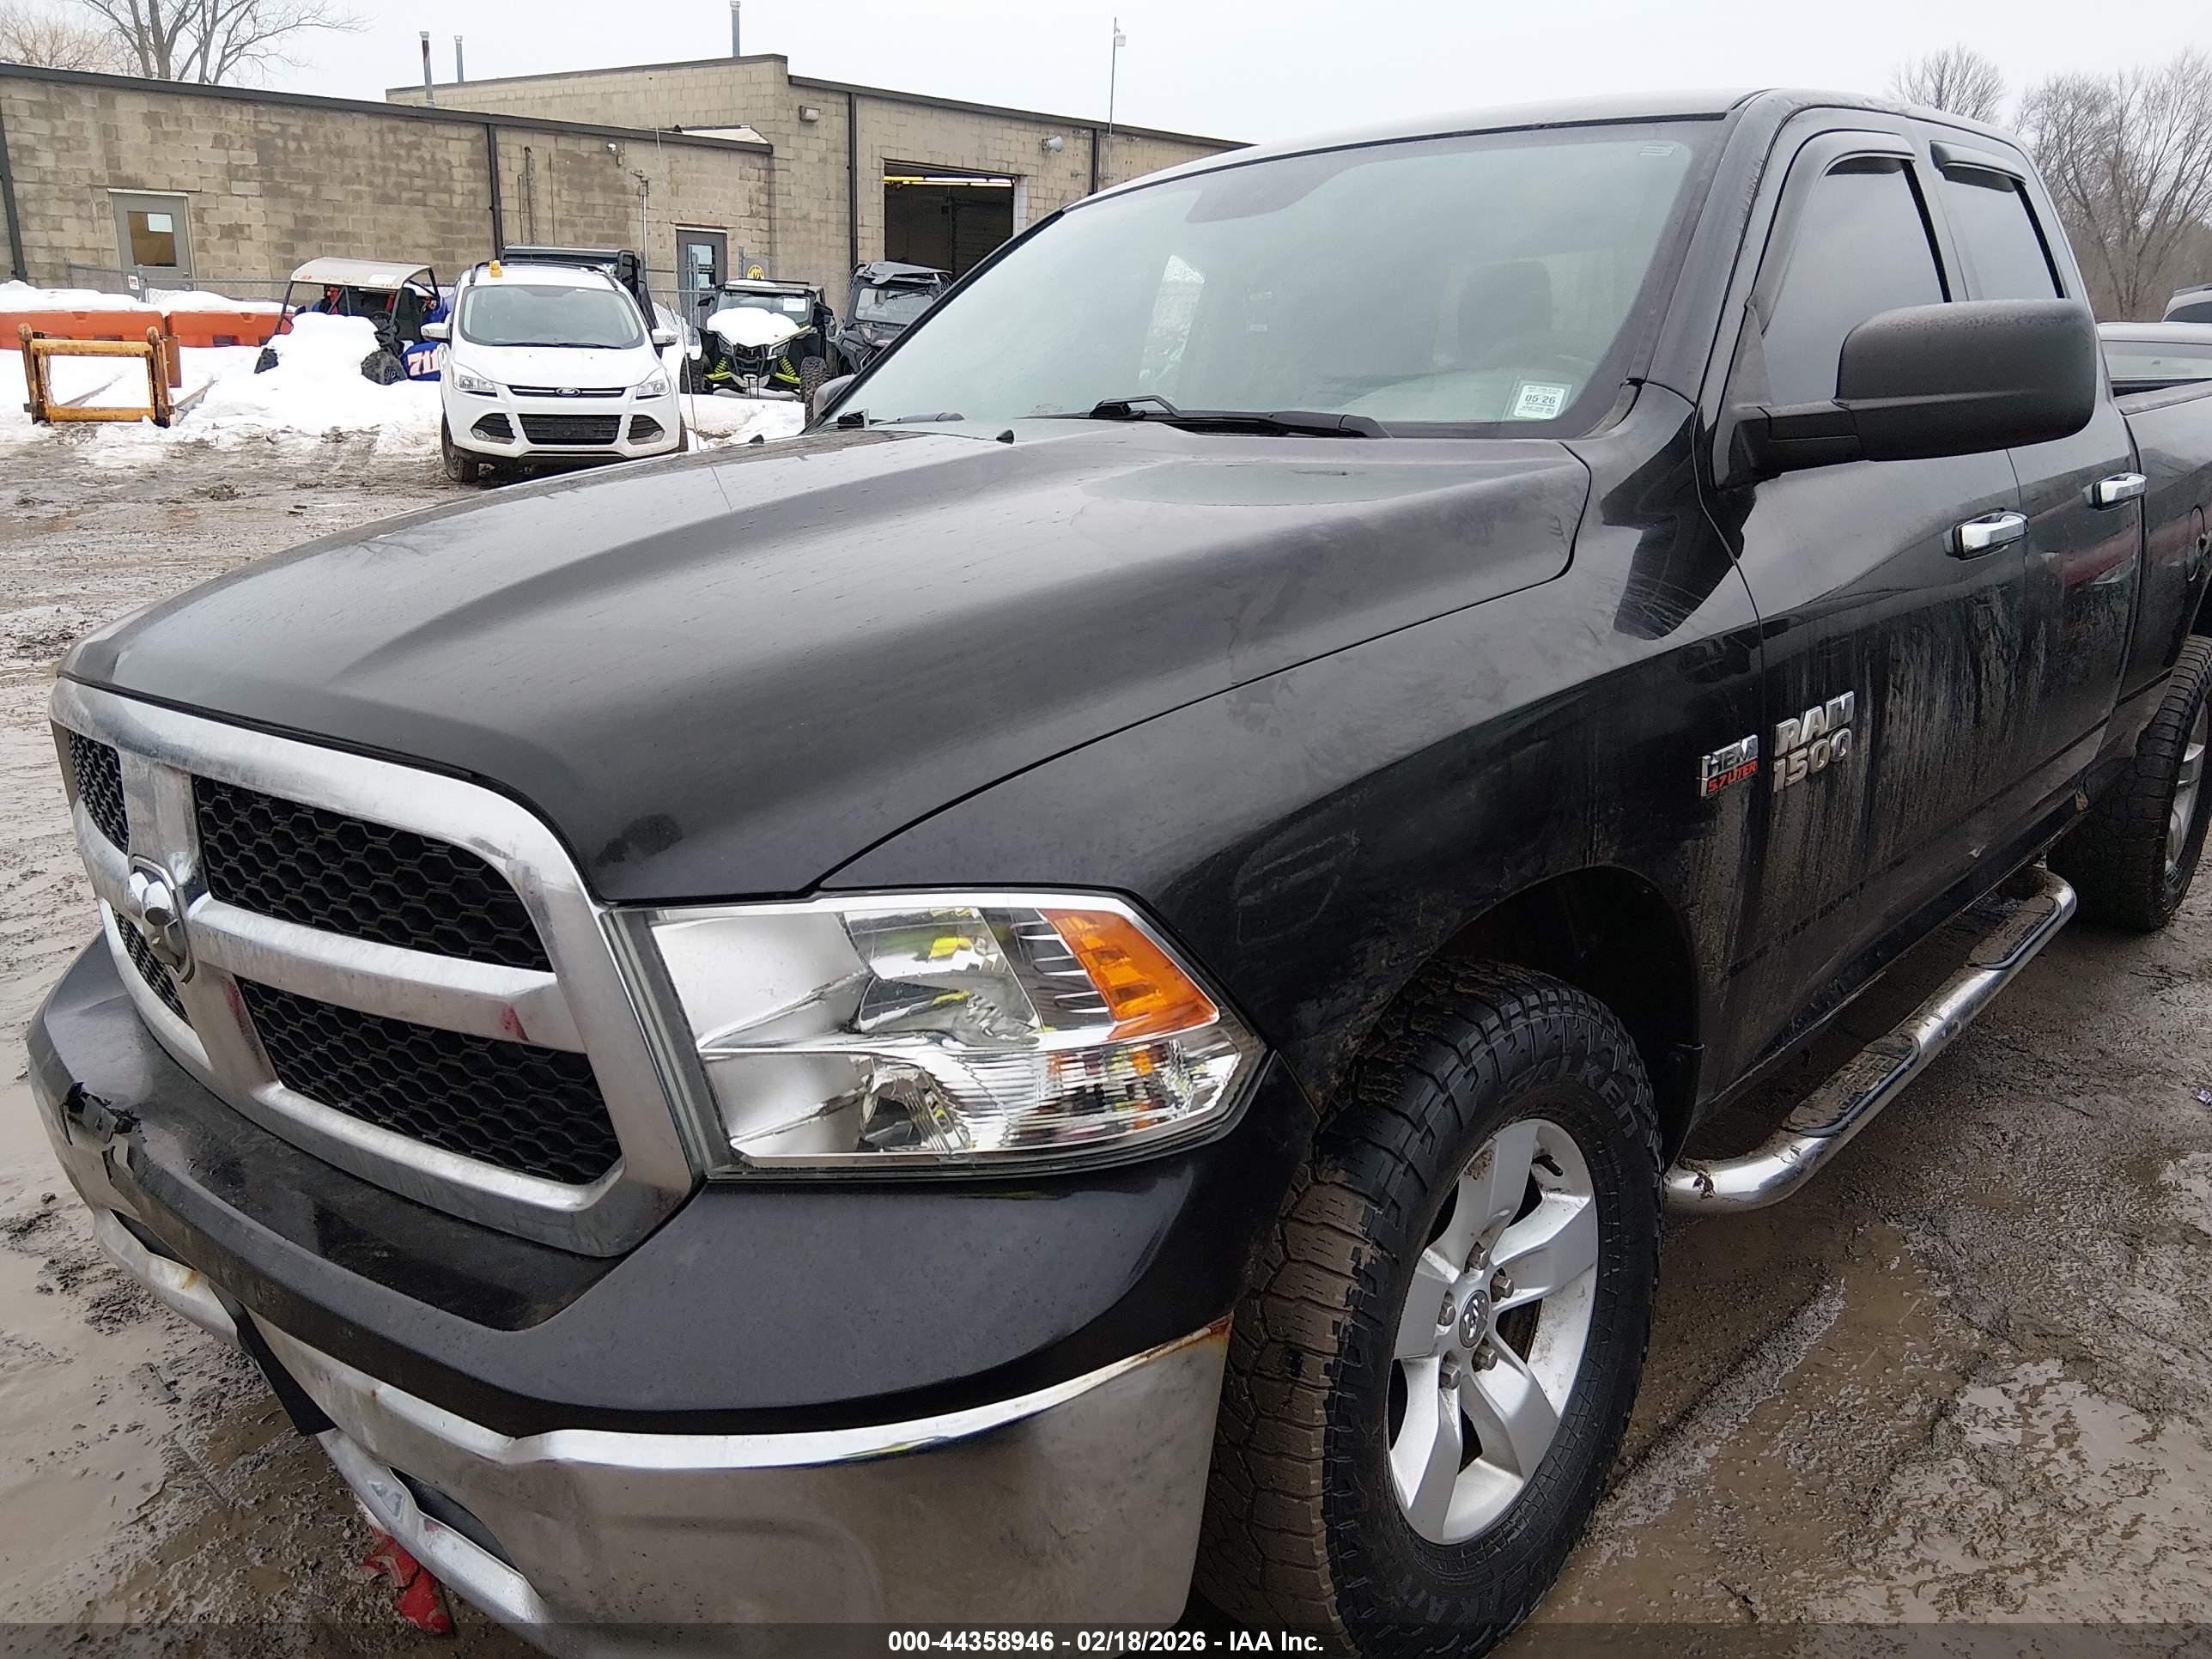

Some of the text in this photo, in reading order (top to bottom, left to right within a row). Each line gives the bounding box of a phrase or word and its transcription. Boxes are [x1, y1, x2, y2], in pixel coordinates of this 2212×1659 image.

[1525, 394, 1556, 404] 05 26
[1775, 690, 1855, 757] RAM
[1773, 727, 1852, 793] 1500
